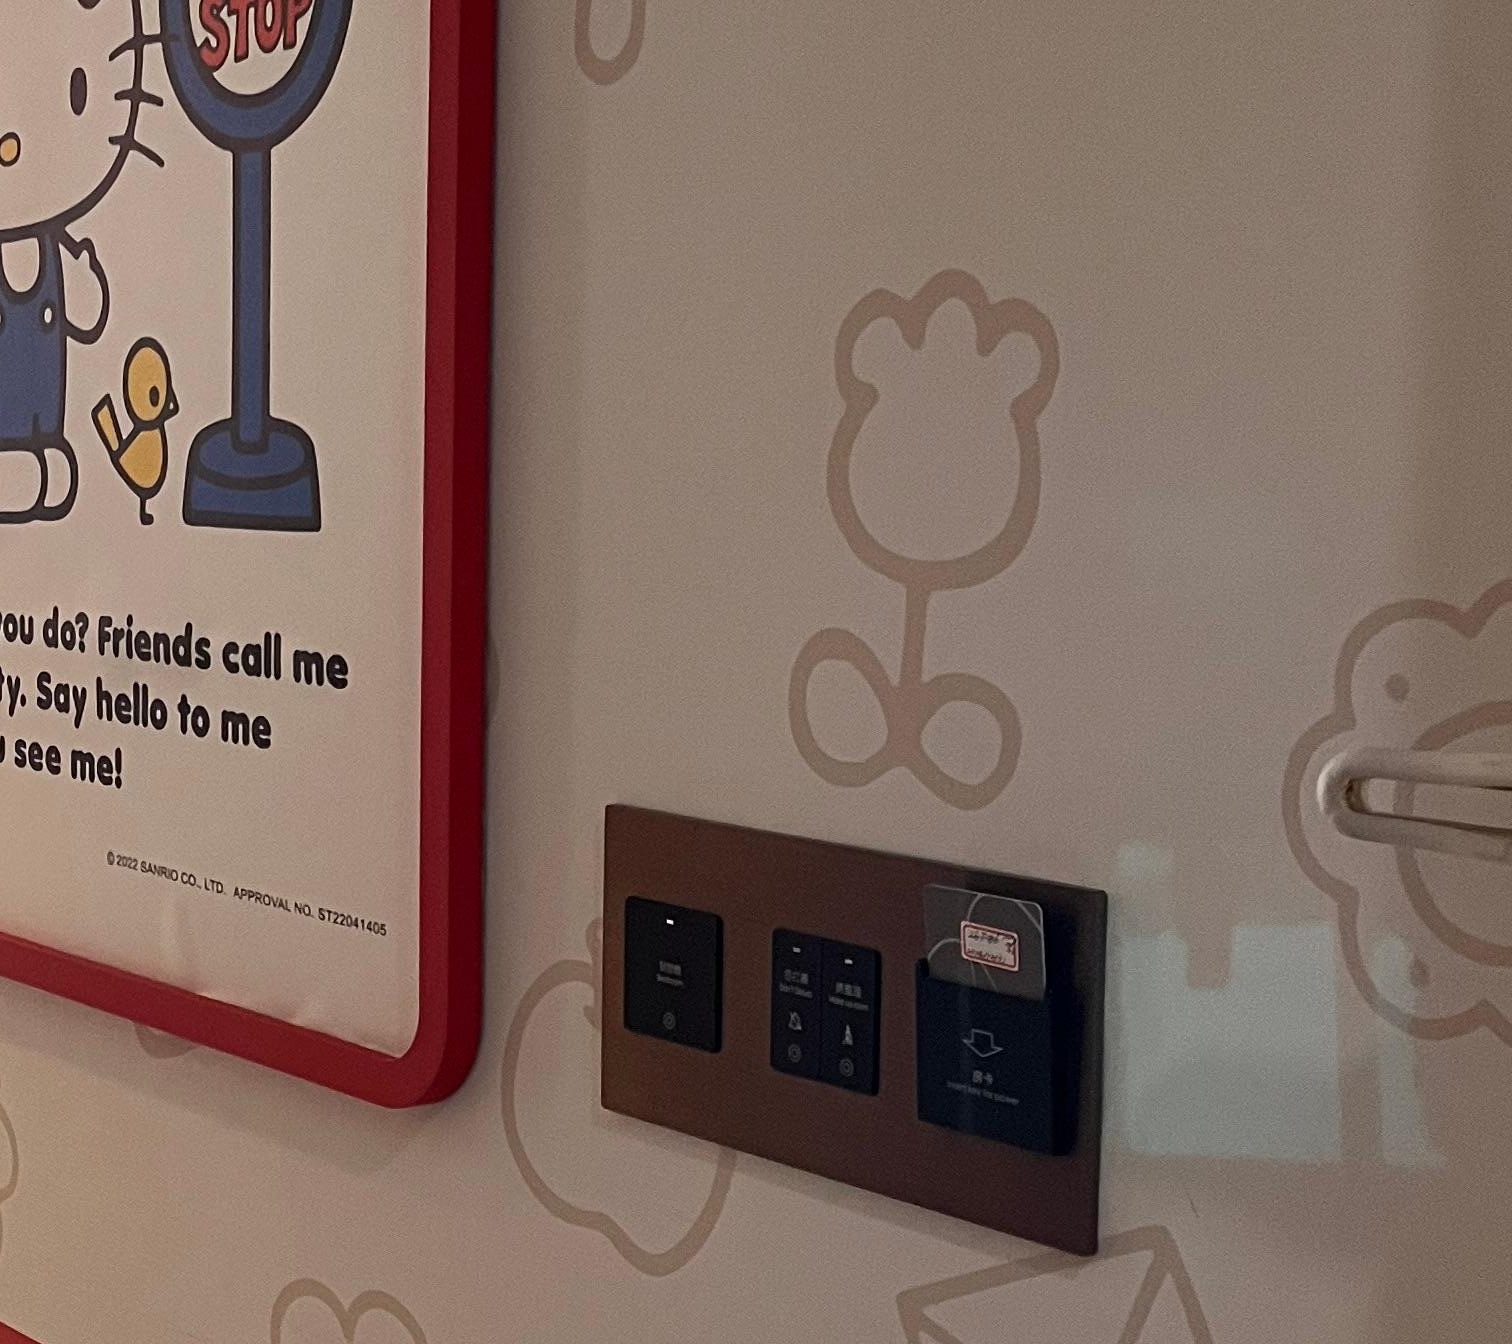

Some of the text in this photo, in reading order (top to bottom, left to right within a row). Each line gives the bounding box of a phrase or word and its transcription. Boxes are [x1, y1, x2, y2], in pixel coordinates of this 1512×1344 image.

[42, 605, 90, 651] do?
[97, 614, 212, 670] Friends
[221, 632, 282, 681] call
[292, 648, 350, 690] me
[36, 672, 87, 728] Say
[95, 676, 169, 731] hello
[177, 694, 211, 738] to
[221, 710, 273, 750] me
[13, 739, 62, 775] see
[69, 748, 124, 789] me!
[115, 854, 139, 871] 2022
[139, 861, 179, 882] SANRIO
[232, 886, 291, 913] APPROVAL
[317, 907, 388, 937] ST22041405
